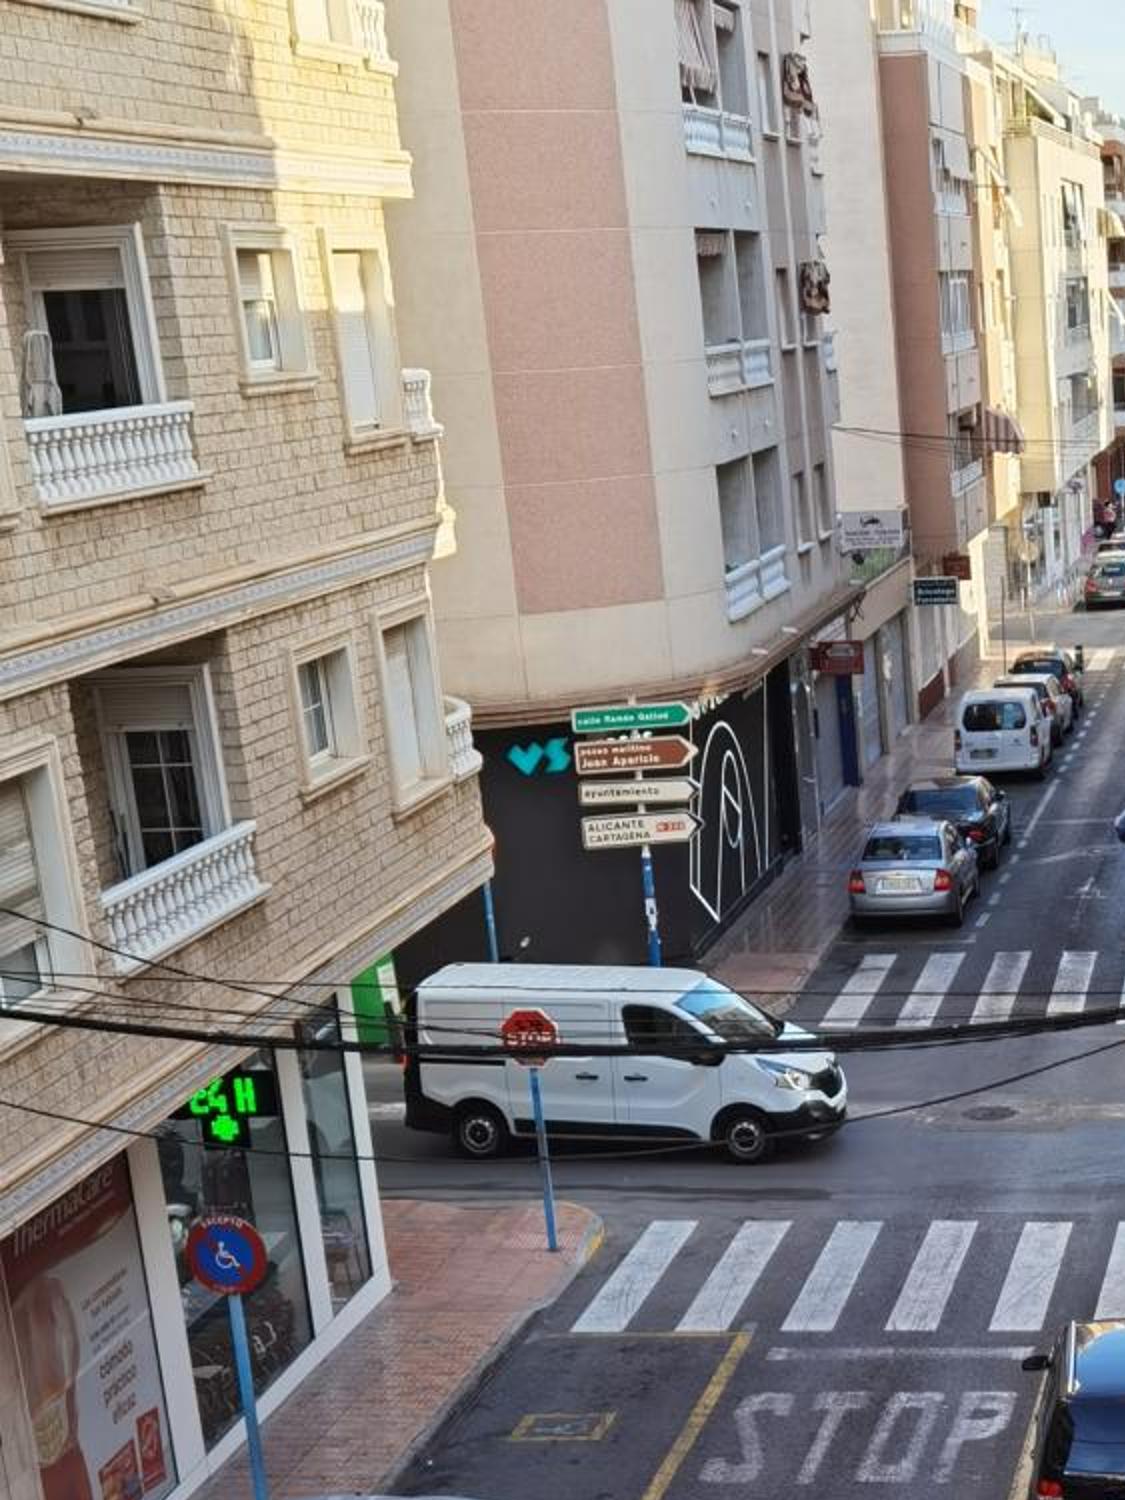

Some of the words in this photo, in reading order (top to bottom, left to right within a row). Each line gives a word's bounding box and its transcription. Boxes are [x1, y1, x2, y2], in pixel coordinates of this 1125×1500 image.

[587, 819, 645, 833] ALICANTE
[589, 830, 651, 843] CARTAGENA
[699, 1391, 1018, 1484] STOP
